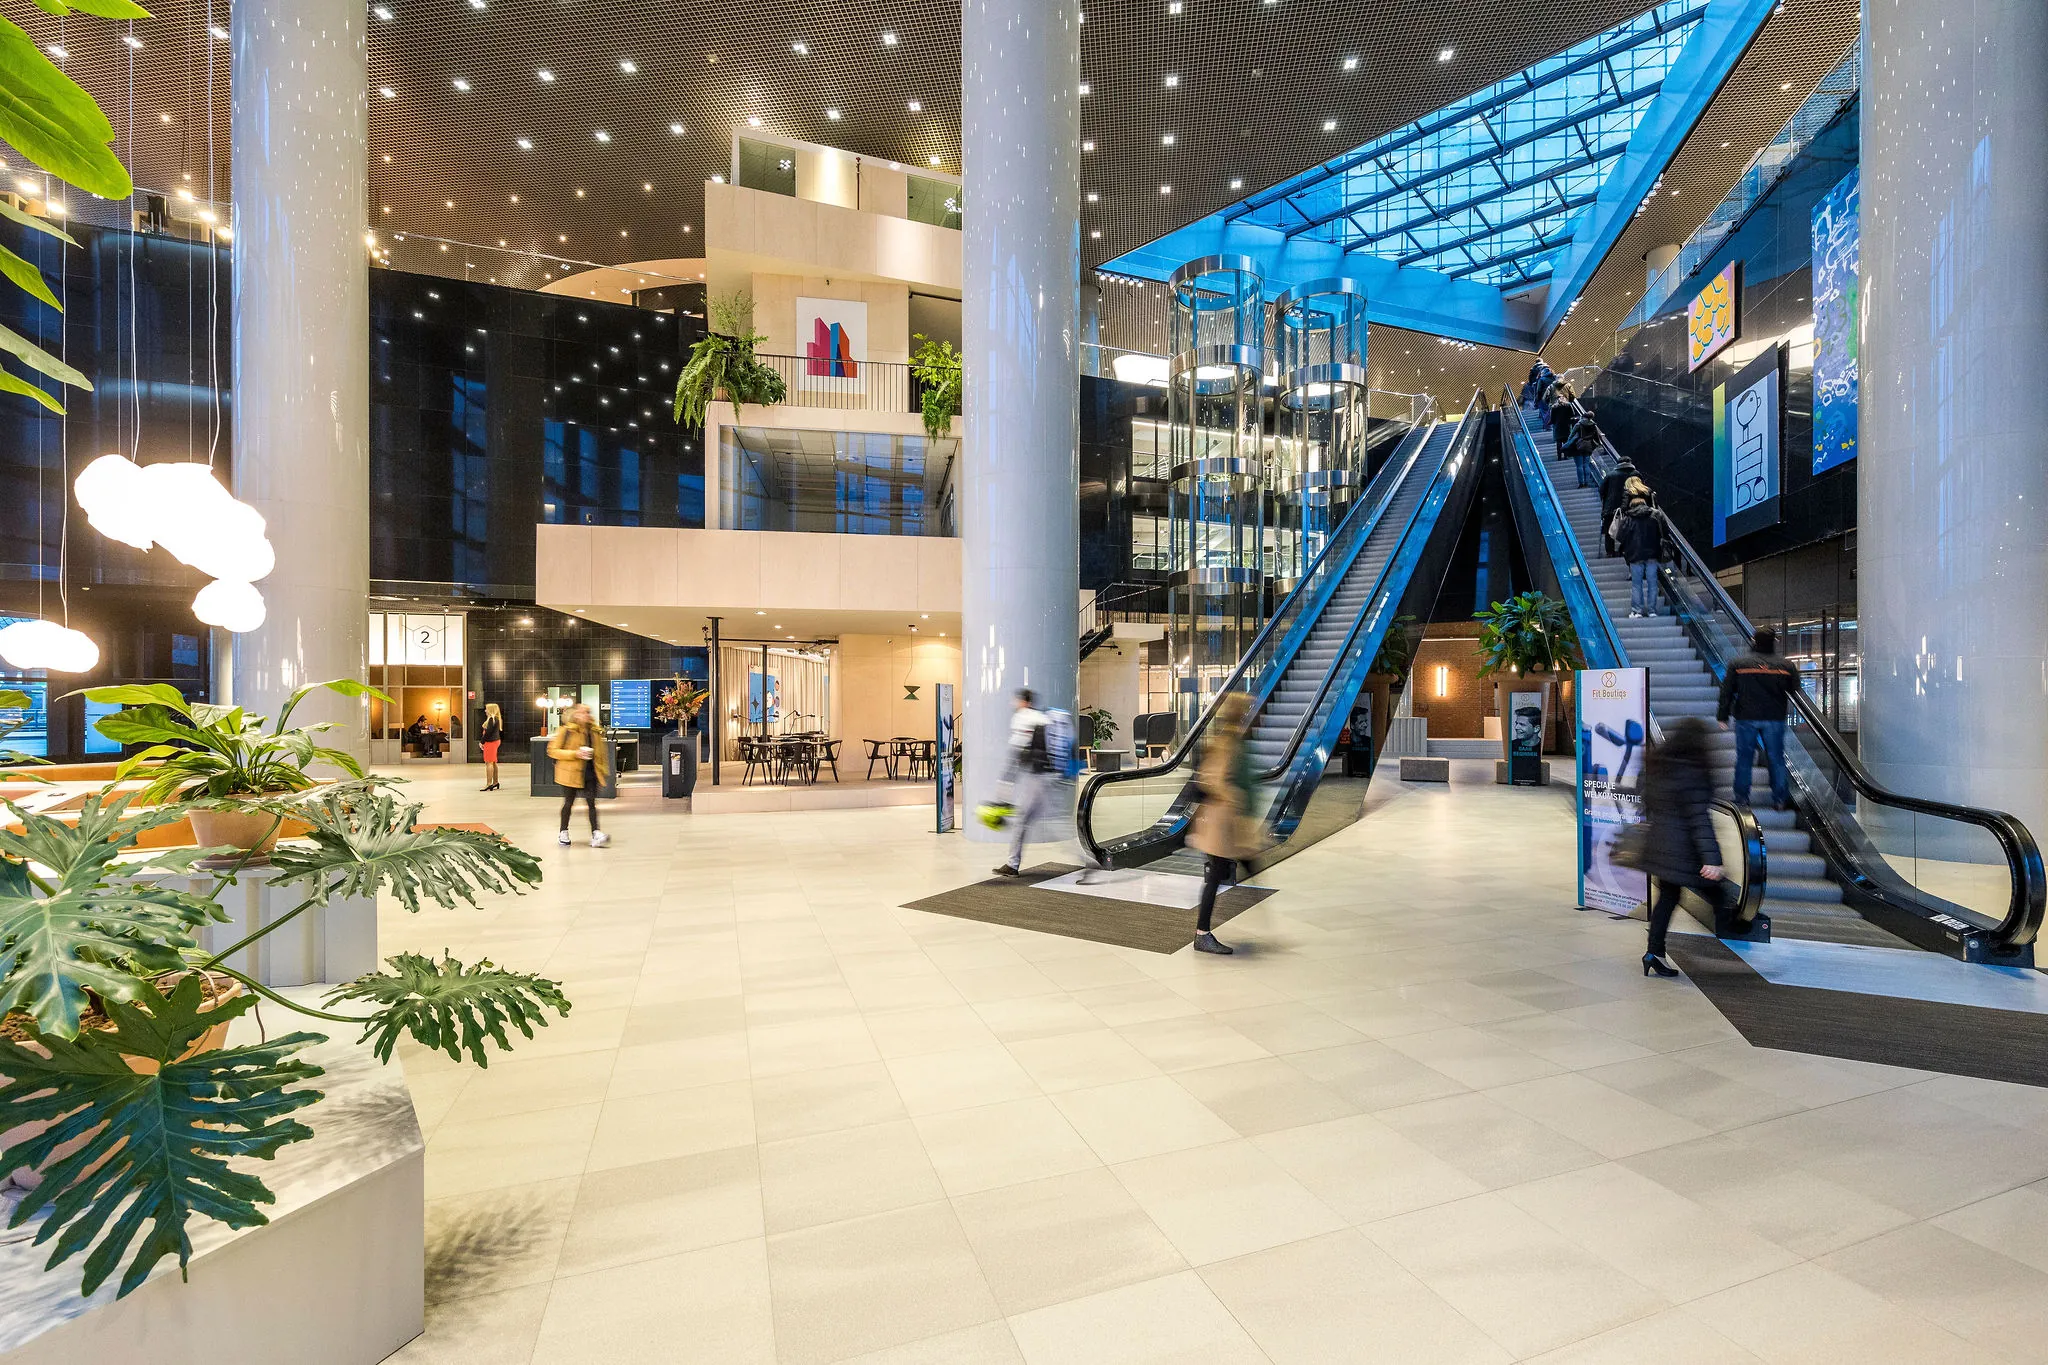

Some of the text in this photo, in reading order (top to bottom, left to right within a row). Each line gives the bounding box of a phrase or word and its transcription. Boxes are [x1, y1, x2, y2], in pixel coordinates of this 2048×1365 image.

[420, 630, 430, 643] 2
[1592, 689, 1601, 697] Fit
[1584, 780, 1616, 789] SPECIALE
[1584, 790, 1641, 803] WELKOMSTACTIE
